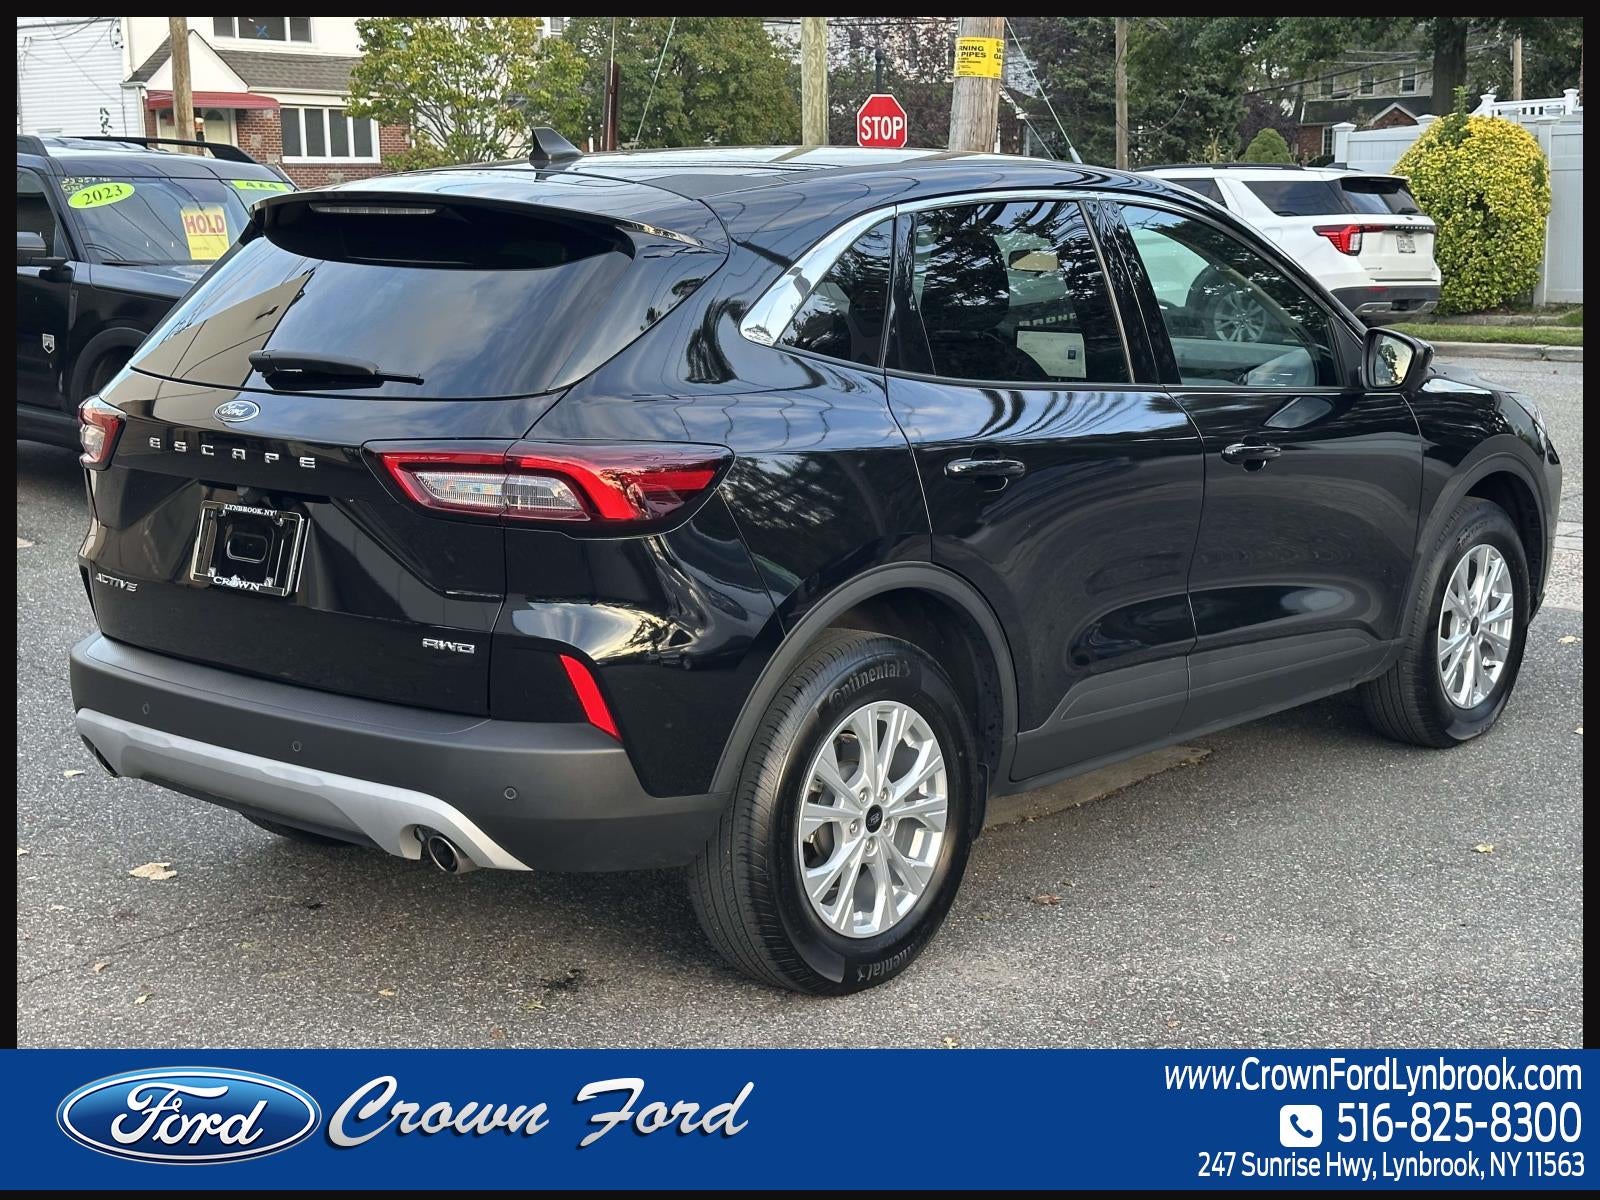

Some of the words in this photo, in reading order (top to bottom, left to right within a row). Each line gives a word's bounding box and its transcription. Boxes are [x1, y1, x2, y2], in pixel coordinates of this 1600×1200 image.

[861, 115, 904, 140] STOP
[82, 184, 123, 205] 2023
[184, 214, 226, 234] HOLD
[149, 437, 316, 469] ESCAPE
[95, 572, 138, 592] ACTIVE
[213, 574, 260, 592] CROWN
[422, 638, 475, 654] AWD
[828, 659, 900, 707] Continental
